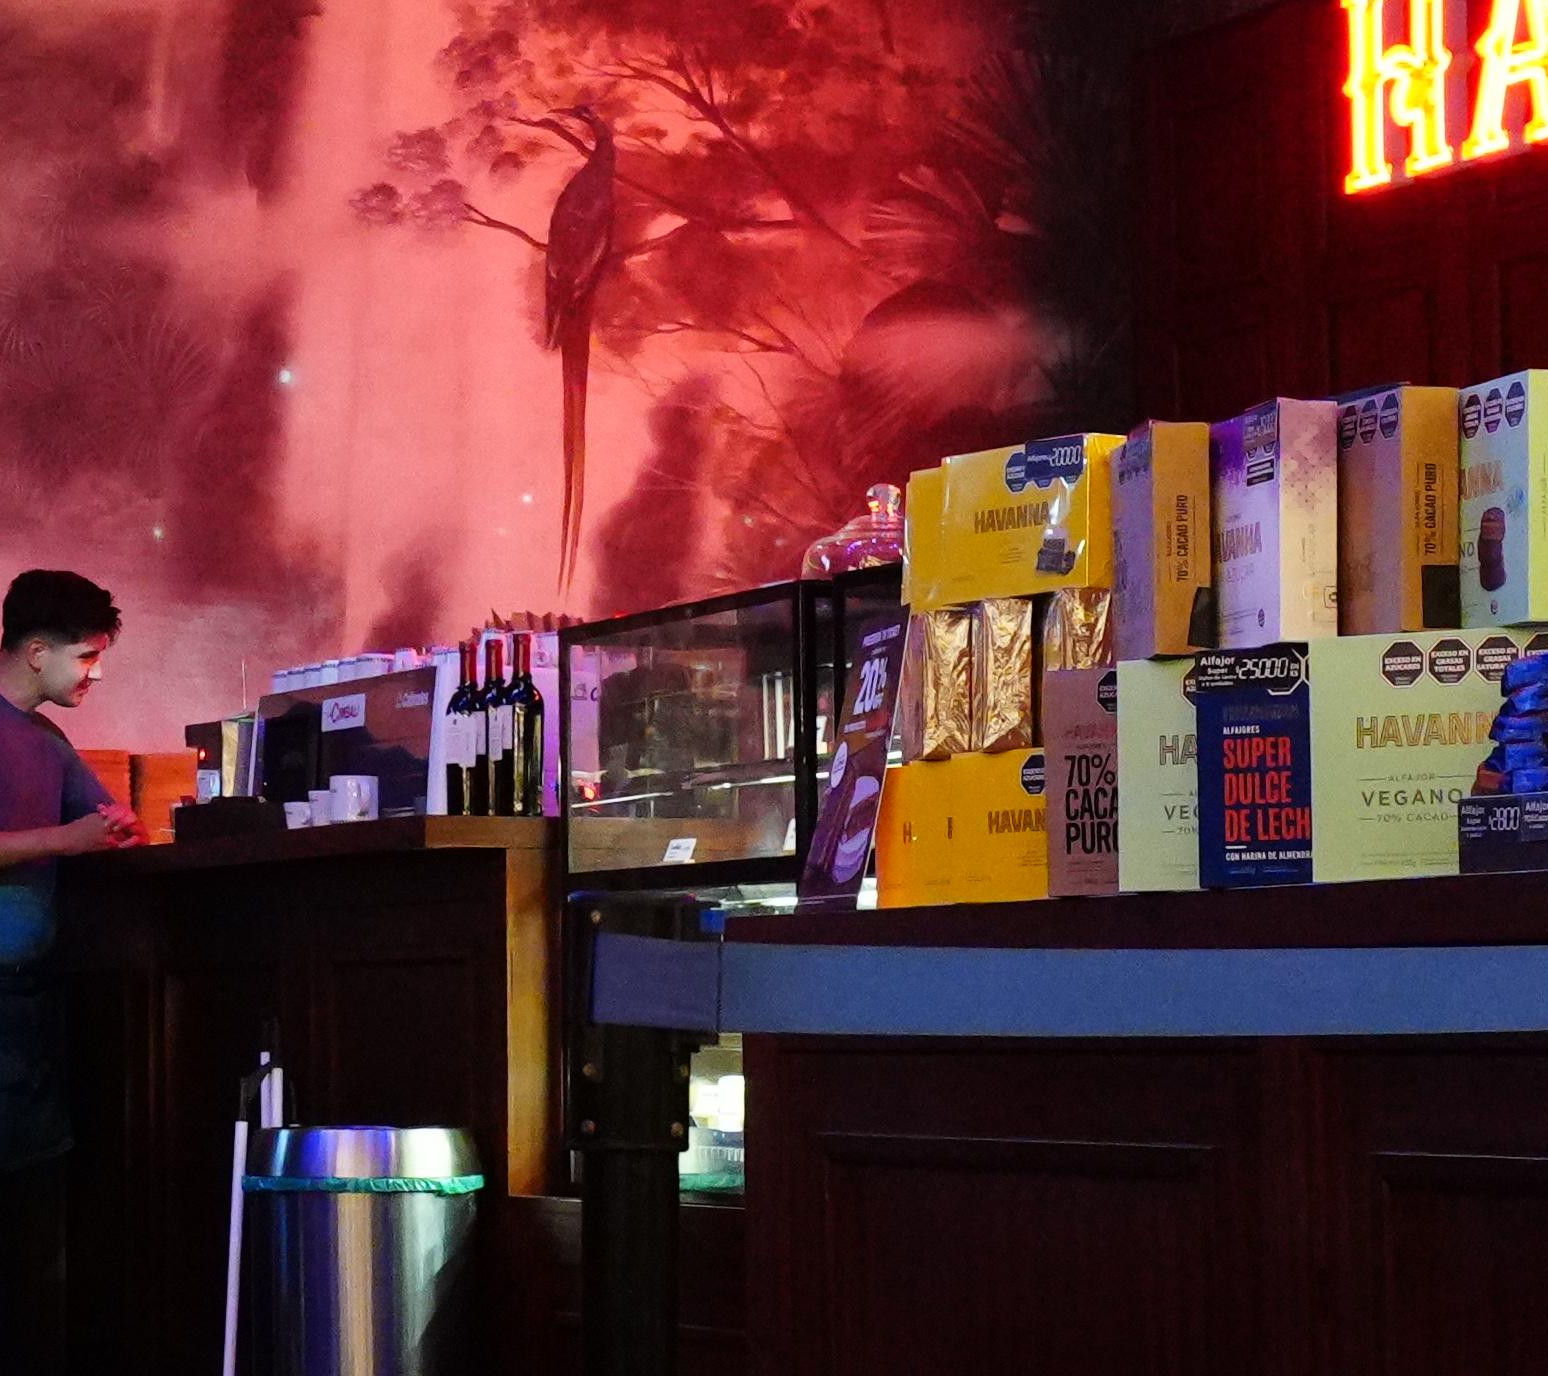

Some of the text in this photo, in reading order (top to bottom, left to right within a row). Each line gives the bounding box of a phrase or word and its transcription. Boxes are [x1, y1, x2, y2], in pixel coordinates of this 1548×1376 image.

[974, 502, 1051, 534] HAVANNA
[1424, 463, 1437, 556] 70% CACAO PURO
[1176, 494, 1188, 582] 70% CACAO PURO
[1200, 655, 1236, 668] Alfajor
[1223, 725, 1260, 735] ALFAJORES
[1223, 737, 1291, 769] SUPER
[1064, 754, 1116, 787] 70%
[1224, 772, 1292, 806] DULCE
[1361, 788, 1463, 807] VEGANO
[1225, 809, 1251, 842] DE
[1225, 852, 1240, 862] CON
[1241, 851, 1266, 861] HARINA
